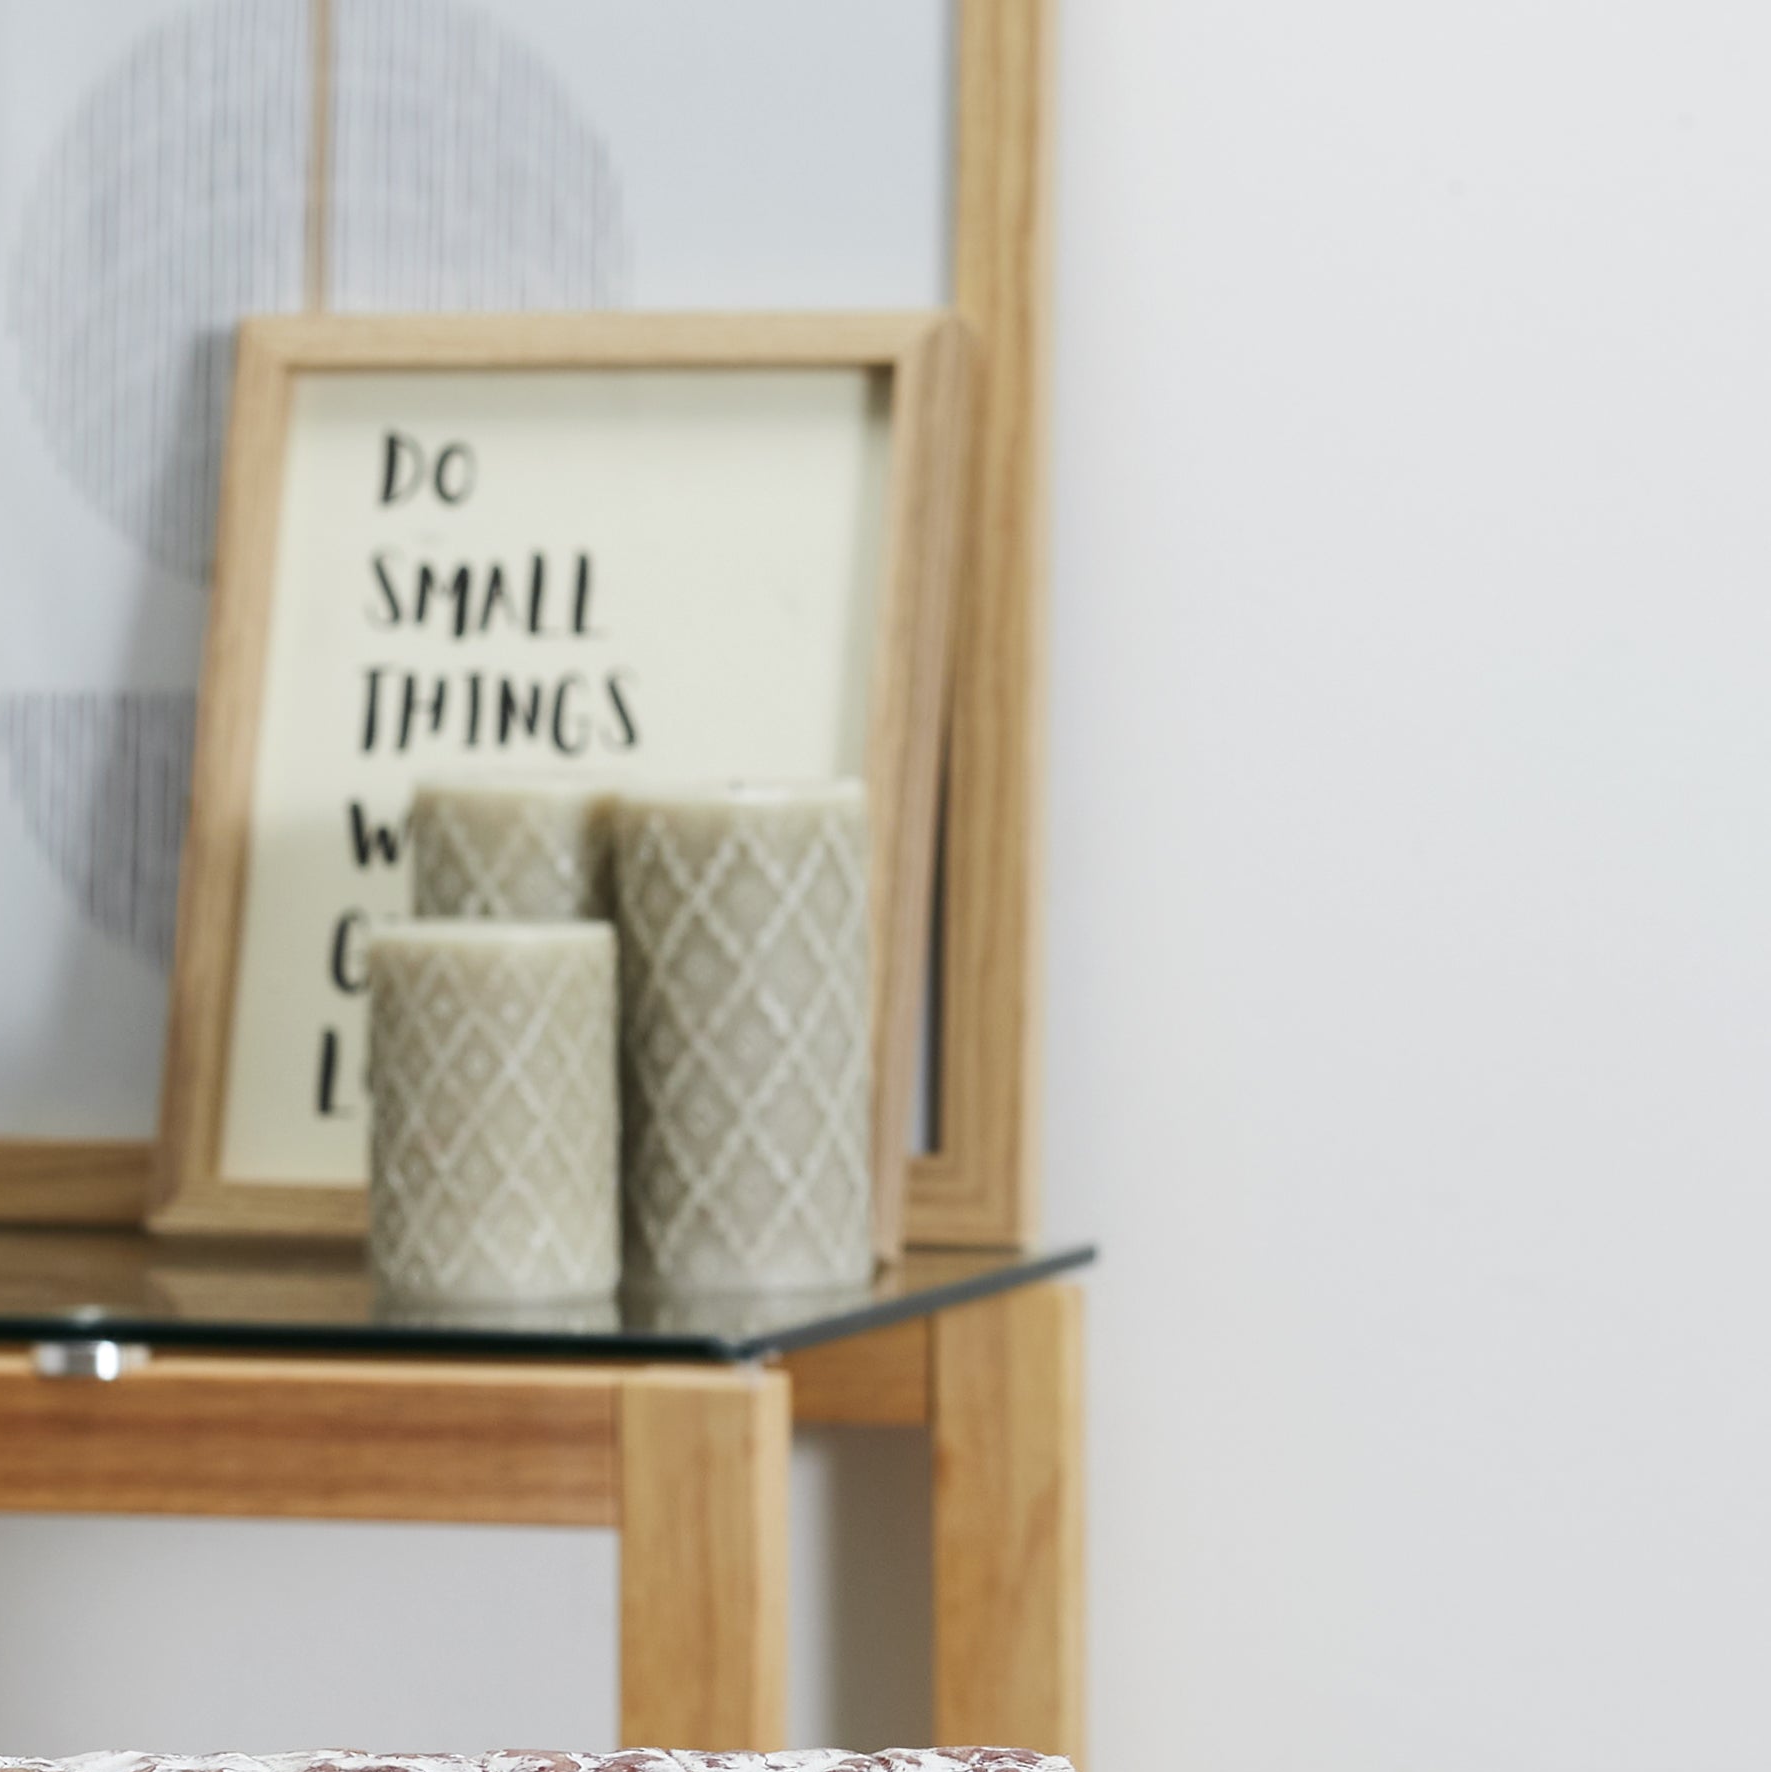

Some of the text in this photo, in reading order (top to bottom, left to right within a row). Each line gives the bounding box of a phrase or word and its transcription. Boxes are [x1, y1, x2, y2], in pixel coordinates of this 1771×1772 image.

[378, 429, 477, 508] DO
[365, 547, 603, 639] SMALL
[358, 666, 638, 755] THINGS
